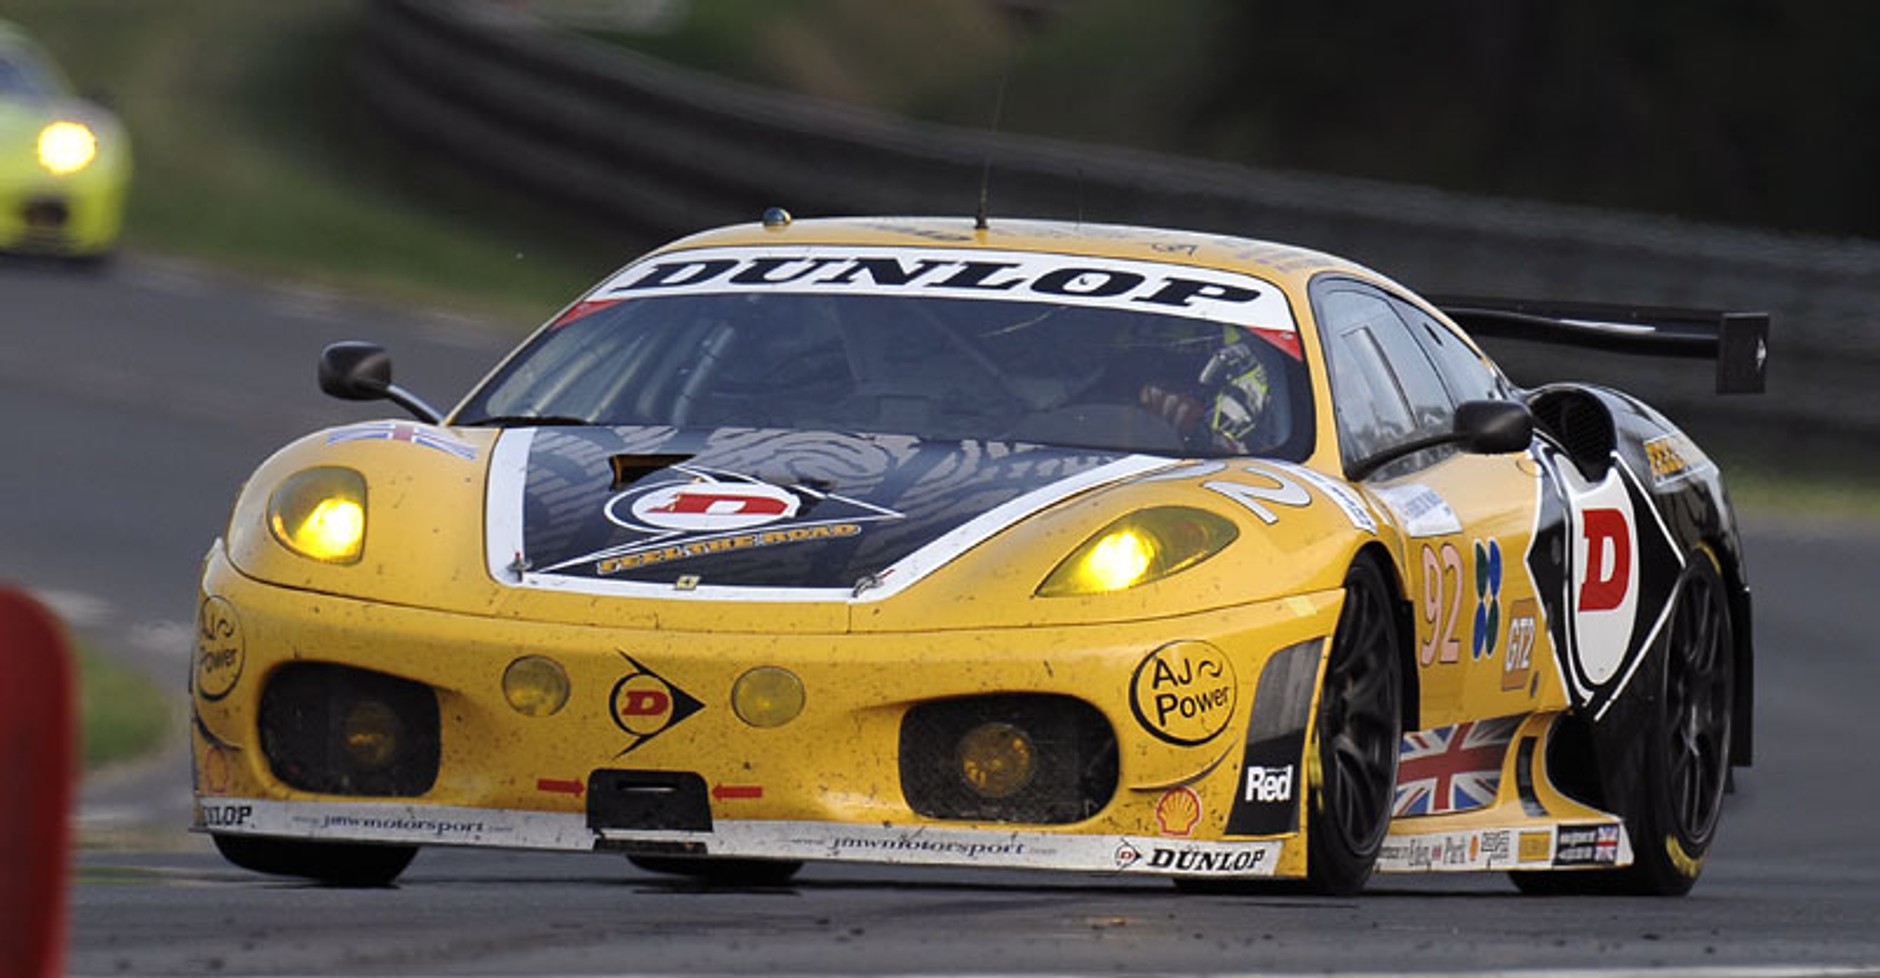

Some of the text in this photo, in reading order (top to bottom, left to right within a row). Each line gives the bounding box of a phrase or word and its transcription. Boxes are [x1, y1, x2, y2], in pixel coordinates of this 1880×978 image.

[609, 257, 1261, 307] DUNLOP
[646, 493, 788, 515] D
[597, 523, 862, 575] FEEL THE ROAD
[1578, 508, 1631, 612] D
[1421, 542, 1463, 667] 92
[1505, 616, 1536, 672] GT2
[1153, 658, 1192, 690] AJ
[621, 691, 669, 716] D
[1155, 686, 1229, 727] Power
[1245, 764, 1294, 802] Red
[1147, 847, 1266, 872] DUNLOP
